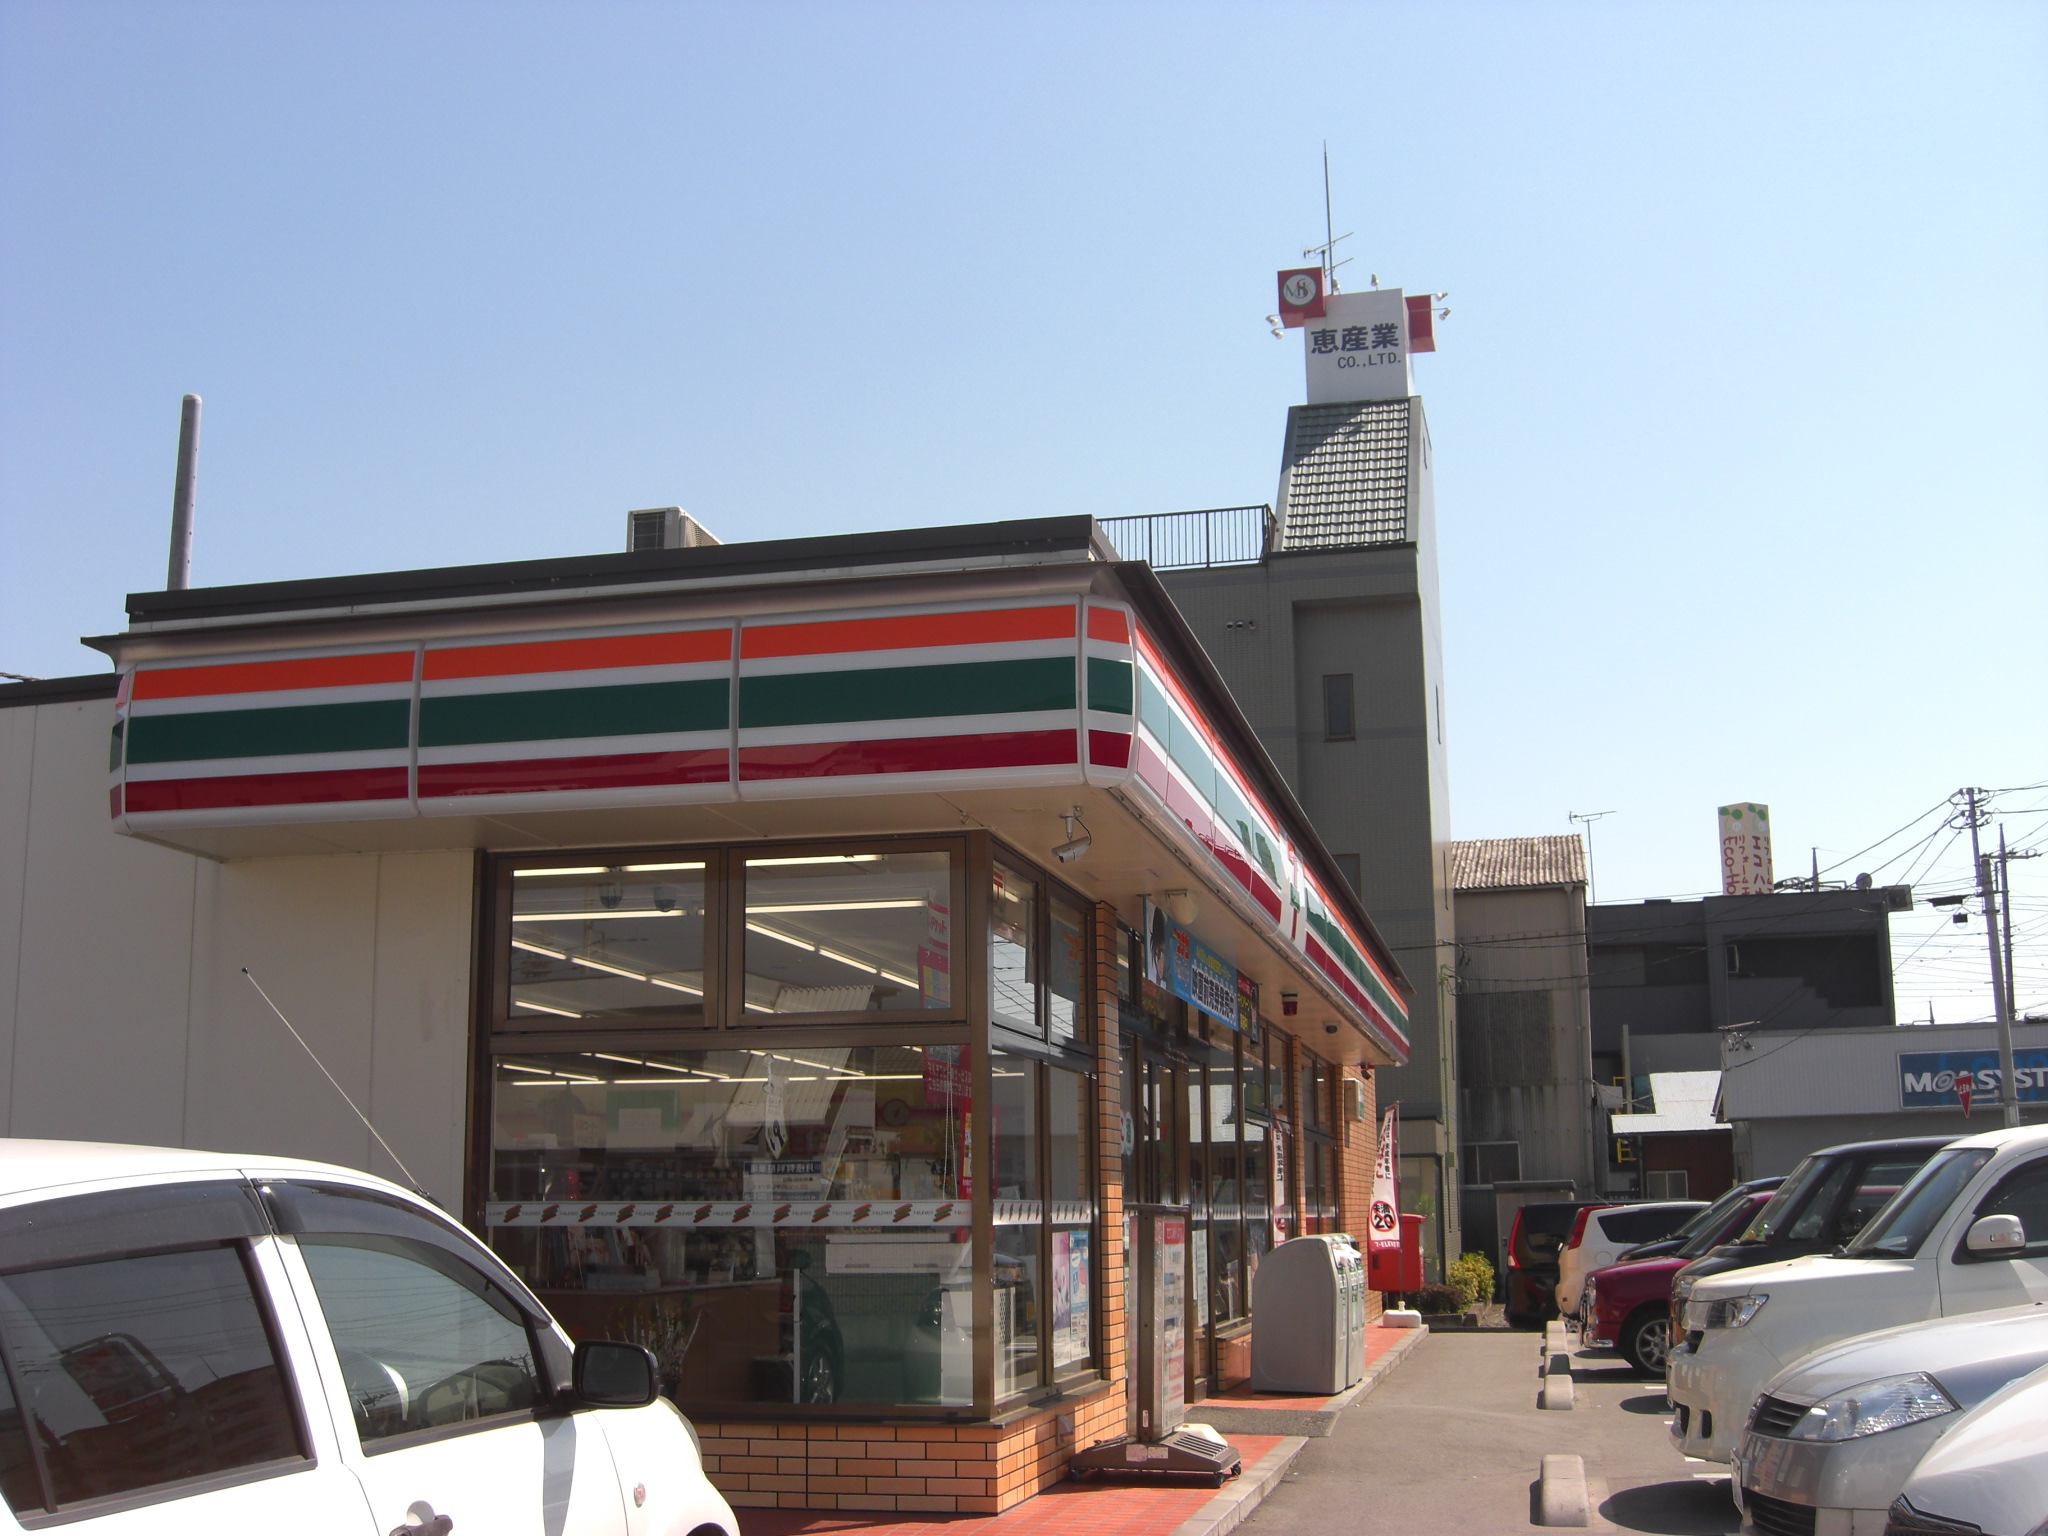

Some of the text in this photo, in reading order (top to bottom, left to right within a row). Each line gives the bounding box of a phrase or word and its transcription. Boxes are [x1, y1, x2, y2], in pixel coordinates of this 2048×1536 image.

[1311, 322, 1399, 354] 恵産業
[1338, 352, 1401, 369] CO.,LTD.
[1374, 1213, 1394, 1229] 20
